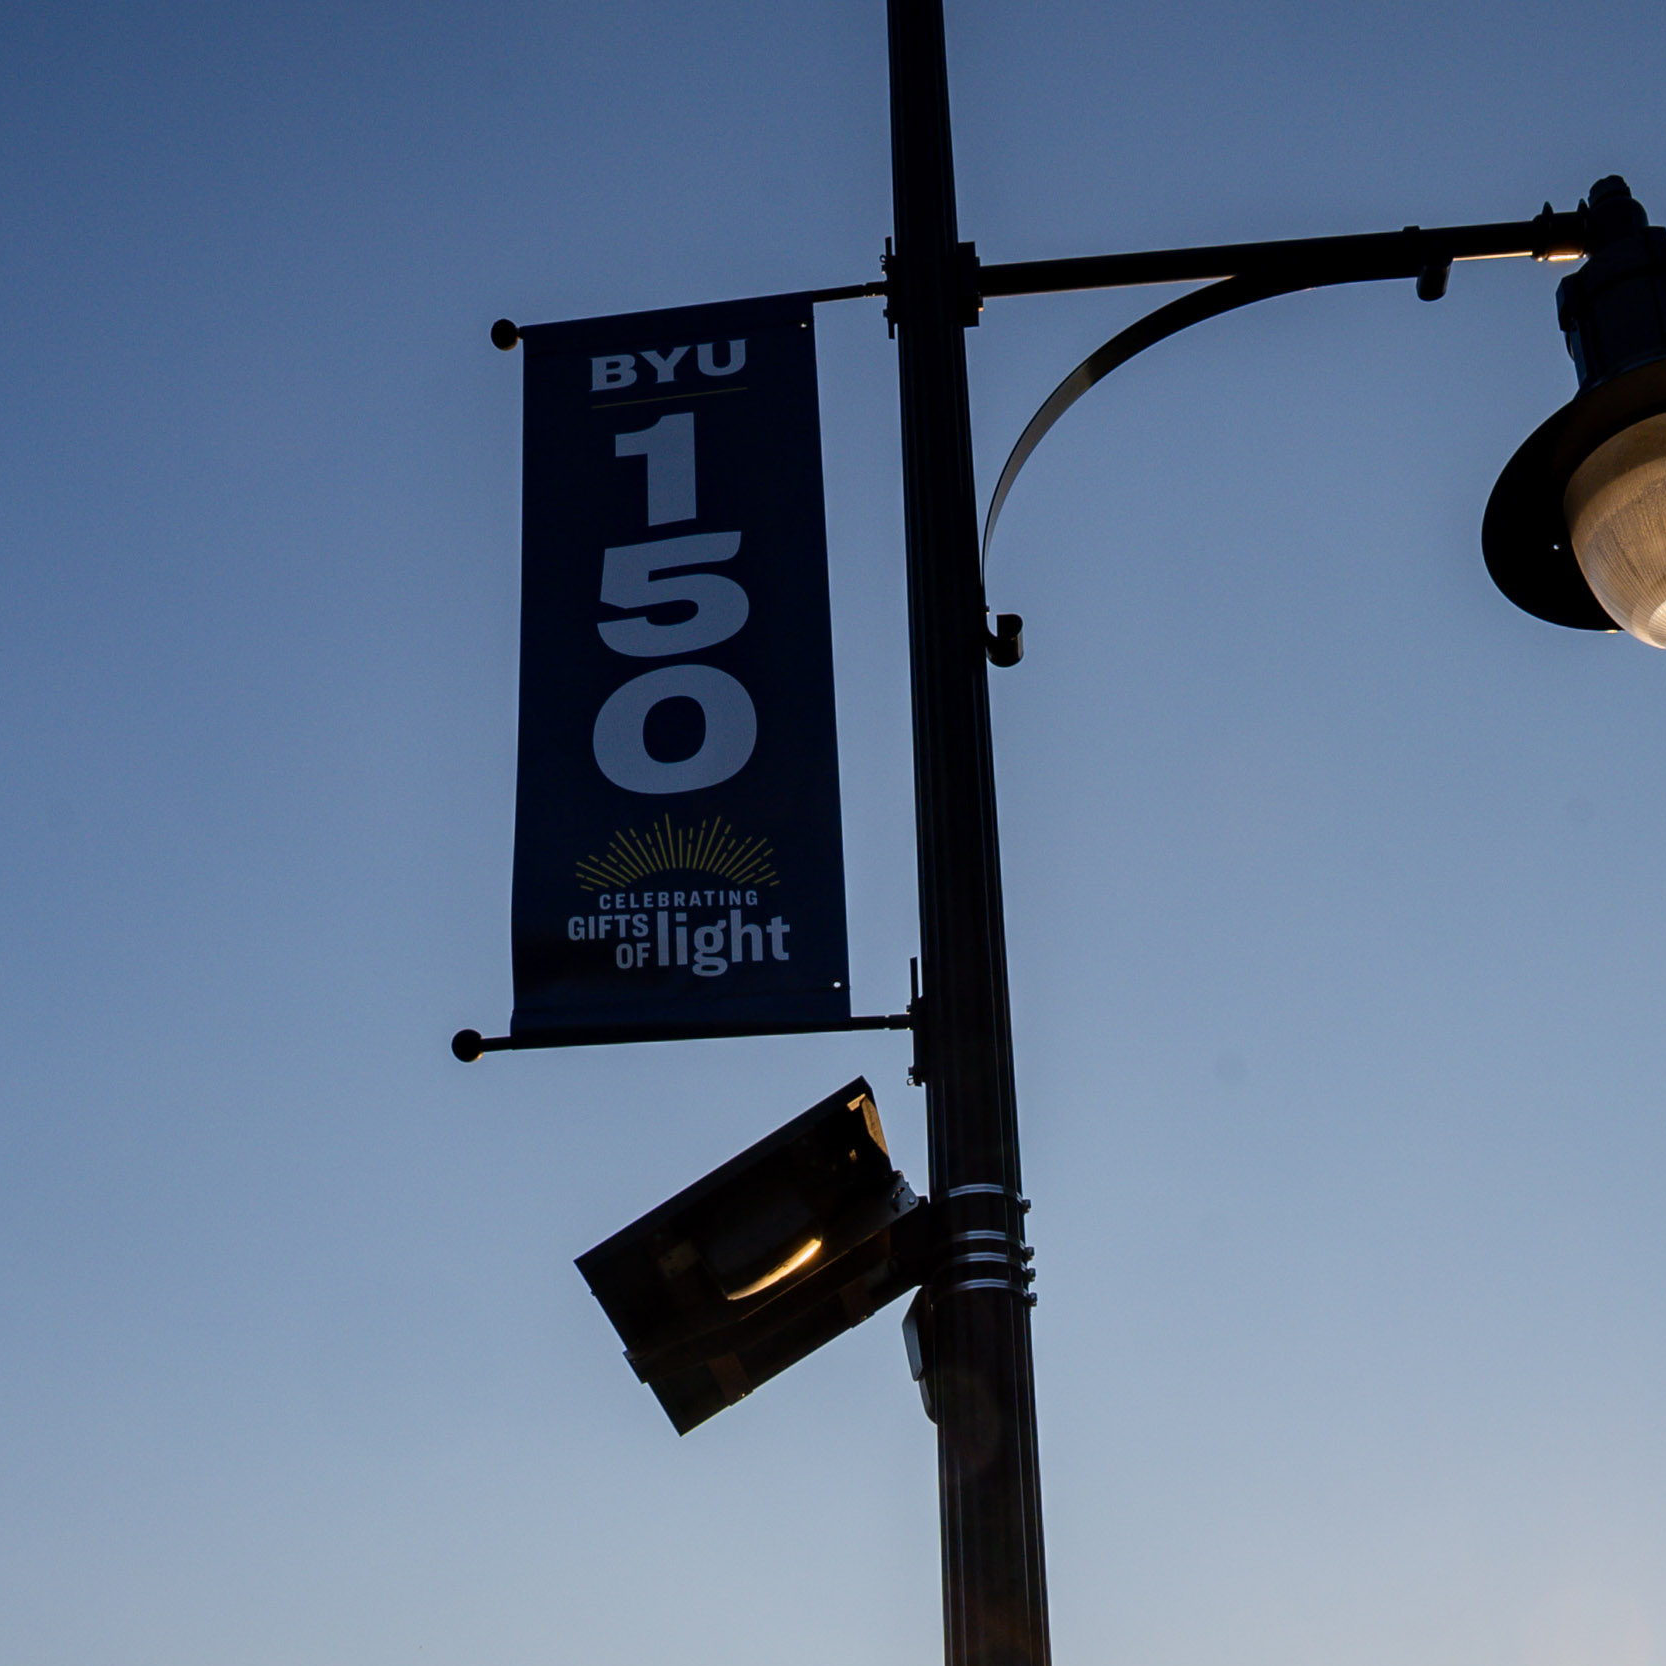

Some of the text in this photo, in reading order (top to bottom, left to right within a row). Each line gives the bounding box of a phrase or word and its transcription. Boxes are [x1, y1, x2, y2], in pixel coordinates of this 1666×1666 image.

[589, 338, 748, 392] BYU
[599, 890, 758, 909] CELEBRATING
[568, 914, 648, 941] GIFTS
[616, 909, 790, 977] OF light
